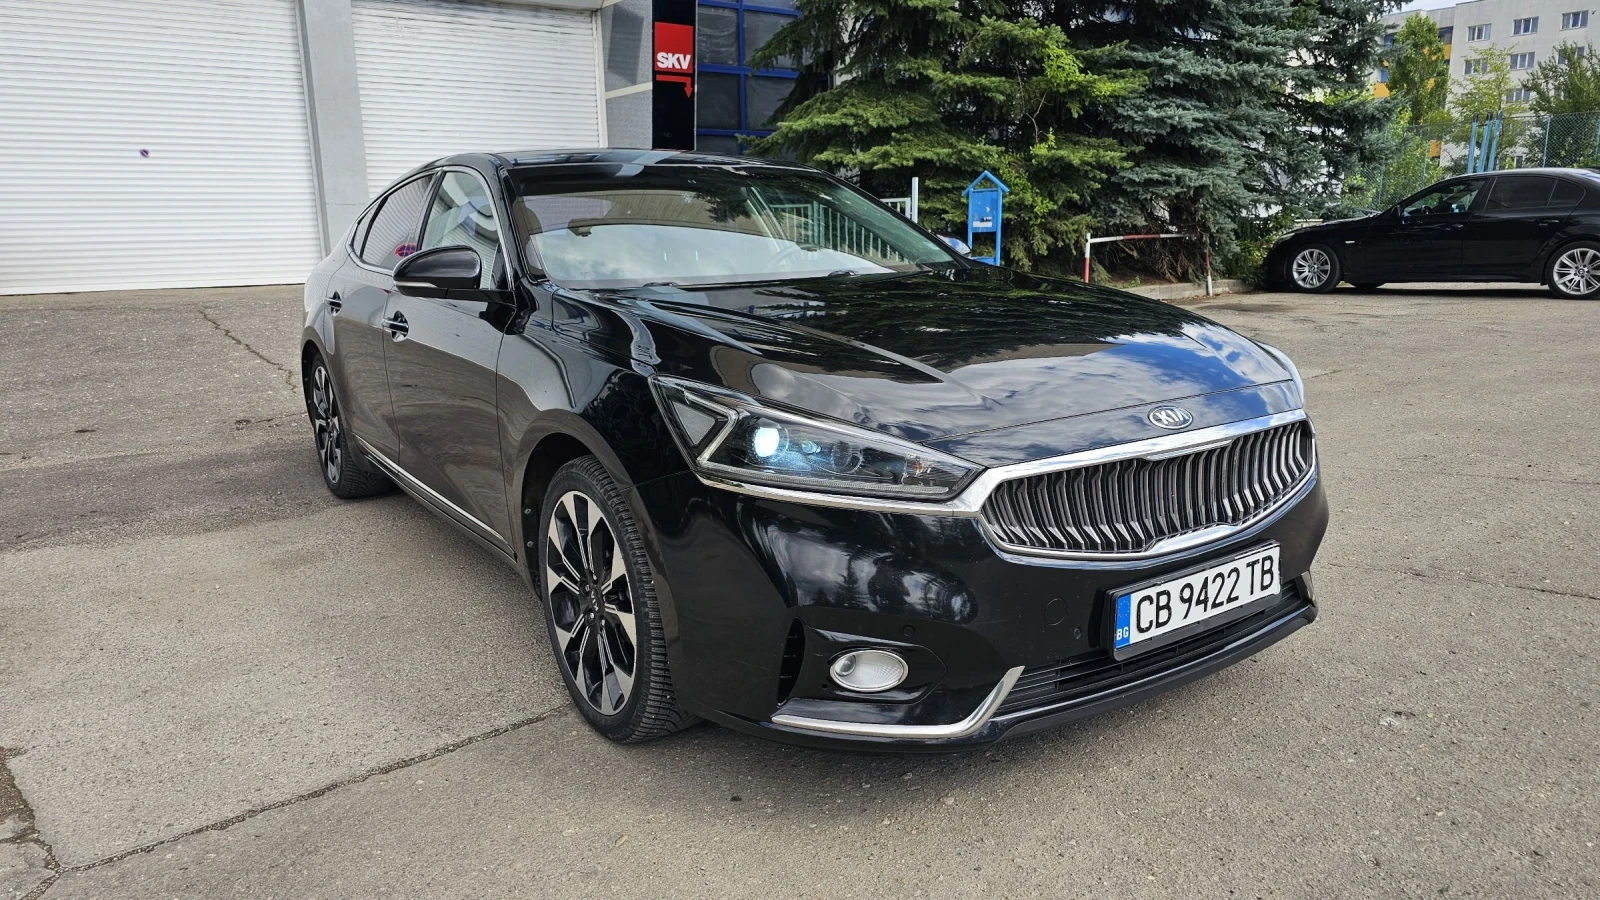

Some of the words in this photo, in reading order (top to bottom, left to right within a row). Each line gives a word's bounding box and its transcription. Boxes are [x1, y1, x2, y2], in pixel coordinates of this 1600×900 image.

[656, 51, 691, 70] SKV
[1154, 408, 1190, 425] KIA
[1136, 589, 1173, 634] CB
[1179, 566, 1240, 621] 9422
[1246, 554, 1275, 597] TB
[1116, 626, 1129, 641] BG
